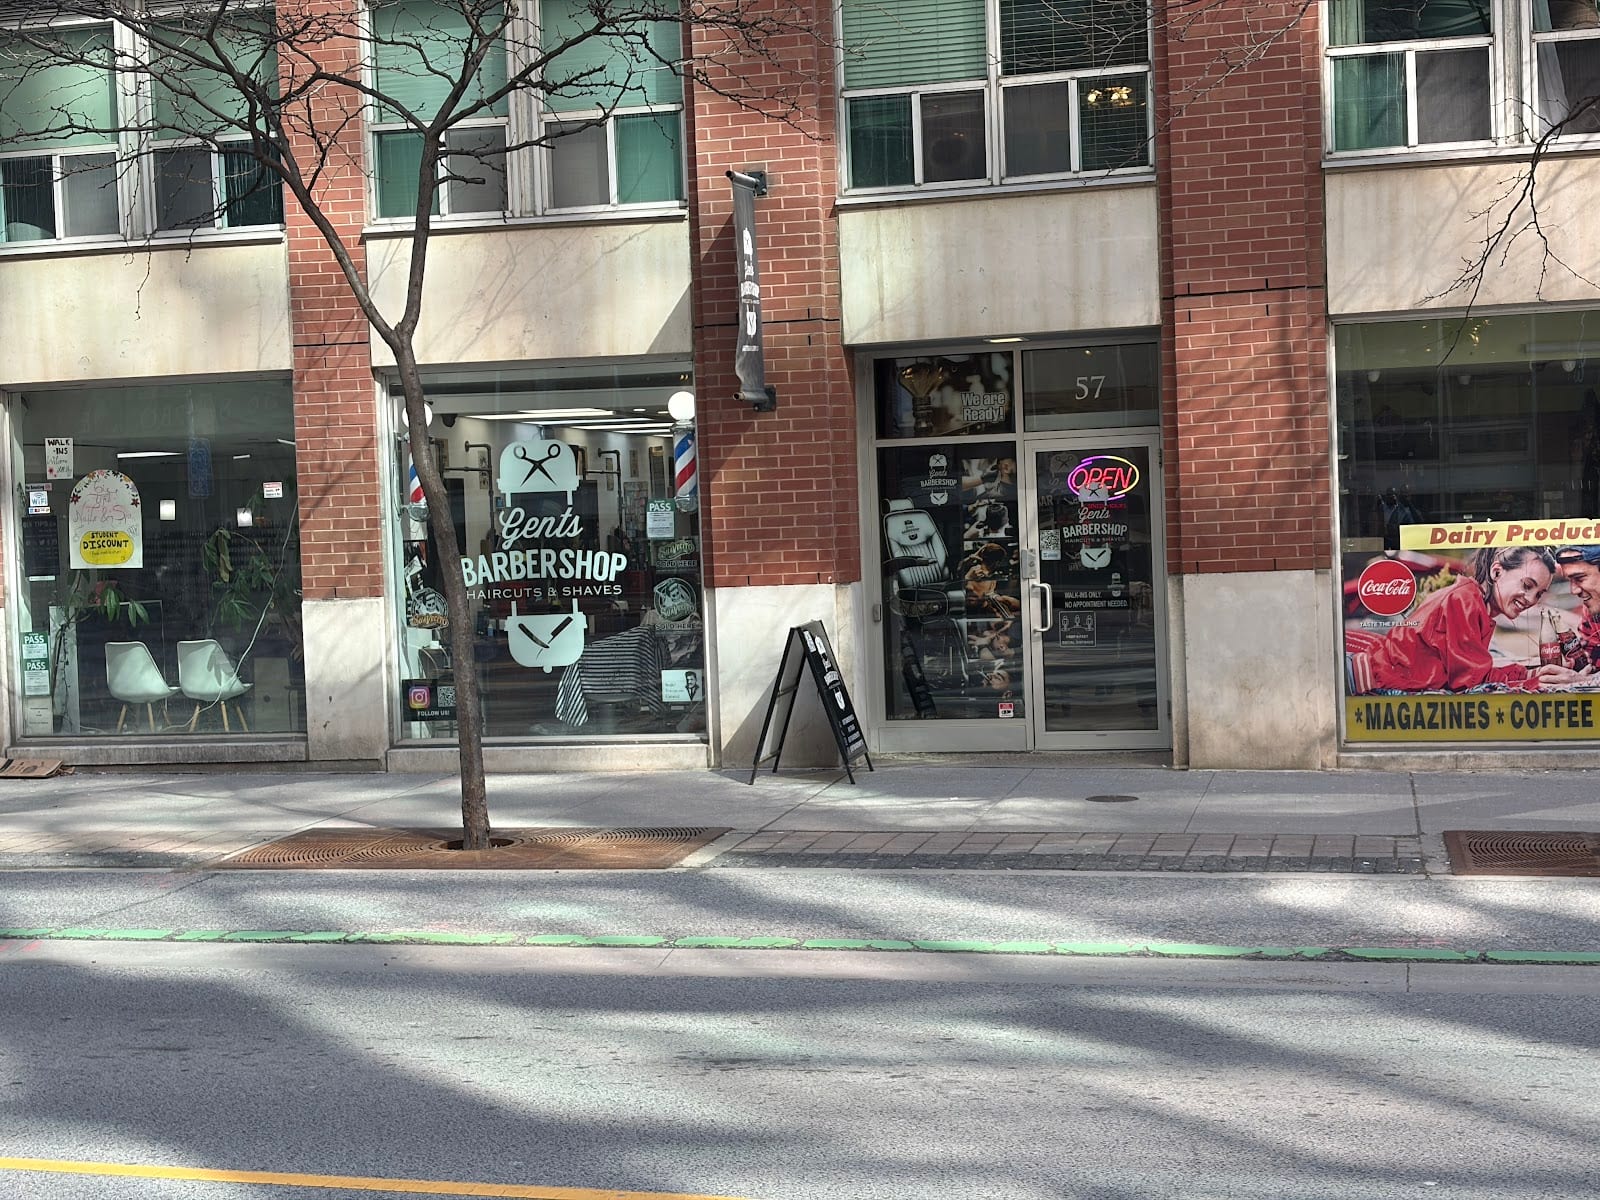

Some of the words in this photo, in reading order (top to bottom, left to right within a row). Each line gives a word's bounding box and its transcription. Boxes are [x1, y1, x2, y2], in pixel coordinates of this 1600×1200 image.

[1075, 375, 1105, 400] 57
[961, 392, 980, 406] We
[983, 392, 1005, 406] are
[963, 406, 1005, 422] Ready!
[47, 439, 70, 447] WALK
[920, 478, 958, 488] BARBERSHOP
[1072, 467, 1132, 489] OPEN
[649, 502, 672, 512] PASS
[1078, 507, 1110, 523] Gents
[91, 531, 119, 539] STUDENT
[499, 506, 583, 550] Gents
[1062, 523, 1128, 539] BARBERSHOP
[1430, 527, 1497, 546] Dairy
[83, 539, 129, 550] DISCOUNT
[460, 549, 627, 587] BARBERSHOP
[466, 587, 543, 600] HAIRCUTS
[548, 587, 557, 597] &
[562, 585, 623, 596] SHAVES
[1361, 578, 1413, 597] Coca-Cola
[1073, 600, 1107, 608] APPOINTMENT
[24, 635, 45, 644] PASS
[26, 661, 46, 670] PASS
[1365, 701, 1490, 730] MAGAZINES
[1510, 699, 1593, 729] COFFEE
